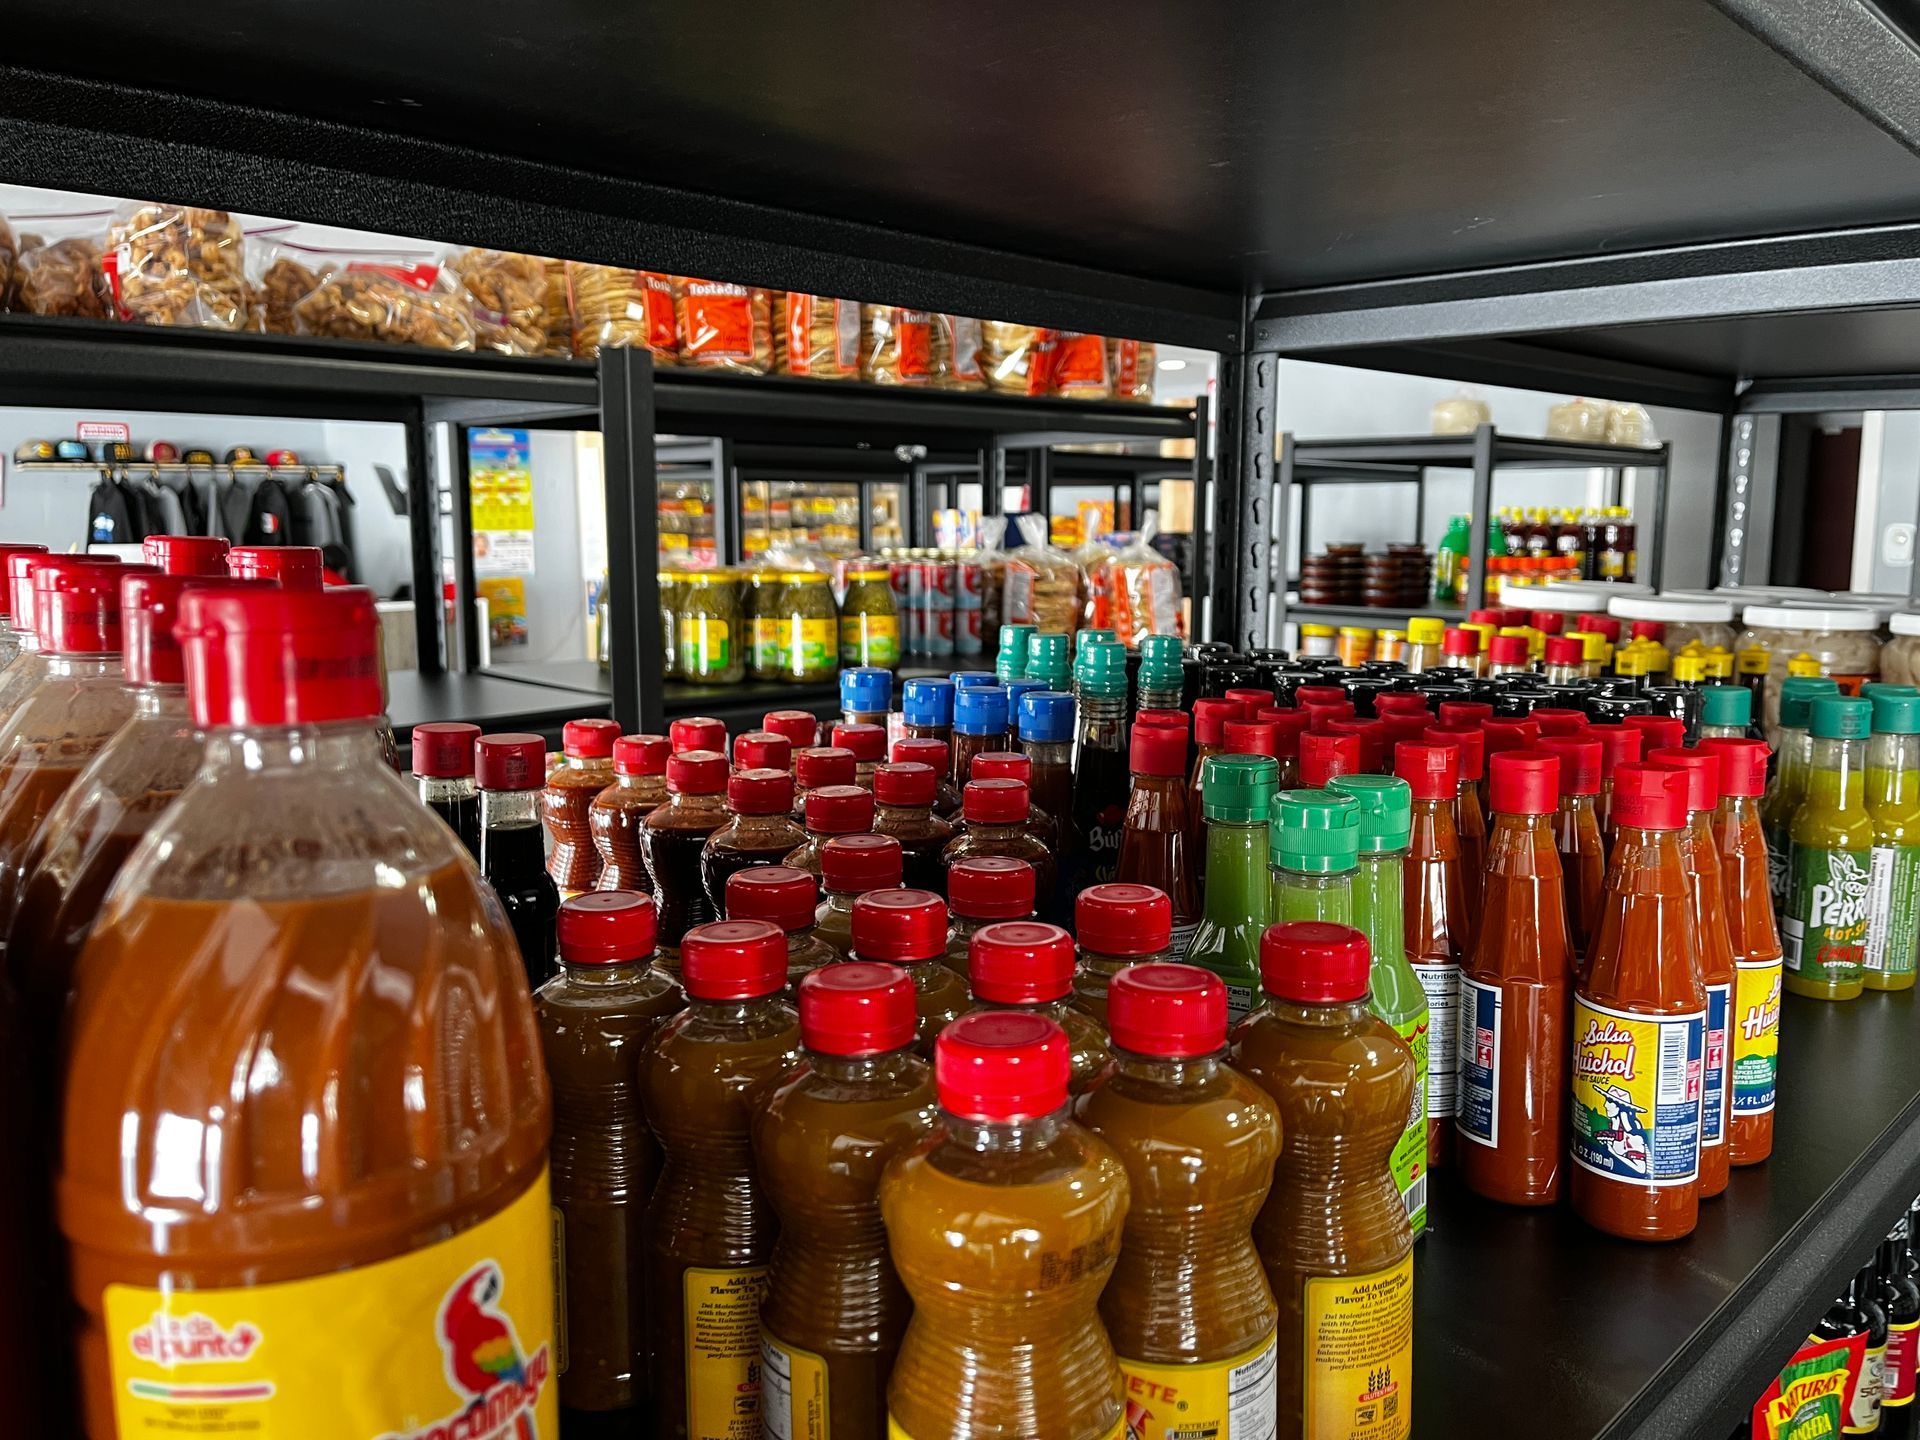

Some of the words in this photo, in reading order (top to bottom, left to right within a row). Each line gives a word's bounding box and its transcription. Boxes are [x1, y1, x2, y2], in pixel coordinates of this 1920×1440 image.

[689, 282, 748, 297] Tostadas
[1421, 972, 1459, 980] Nutrition
[1583, 1018, 1632, 1046] Salsa
[1572, 1043, 1636, 1081] Huichol
[1589, 1075, 1611, 1085] SAUCE
[727, 1277, 747, 1287] Add
[1351, 1283, 1370, 1295] Add
[1371, 1273, 1403, 1292] Authentic
[710, 1286, 741, 1295] Flavor
[1334, 1296, 1364, 1305] Flavor
[1366, 1292, 1377, 1301] To
[1379, 1286, 1395, 1297] Your
[1360, 1302, 1374, 1310] ALL
[1351, 1318, 1371, 1328] finest
[1342, 1323, 1376, 1334] Habanero
[1334, 1340, 1365, 1349] enriched
[1317, 1348, 1351, 1357] balanced
[1351, 1346, 1367, 1354] with
[1367, 1344, 1378, 1352] the
[1347, 1355, 1360, 1363] Del
[1235, 1354, 1266, 1377] Nutrition
[1329, 1363, 1355, 1372] perfect
[1363, 1391, 1384, 1401] GLUTEN
[1777, 1374, 1843, 1420] NATURAS
[1178, 1420, 1221, 1431] EXTREME
